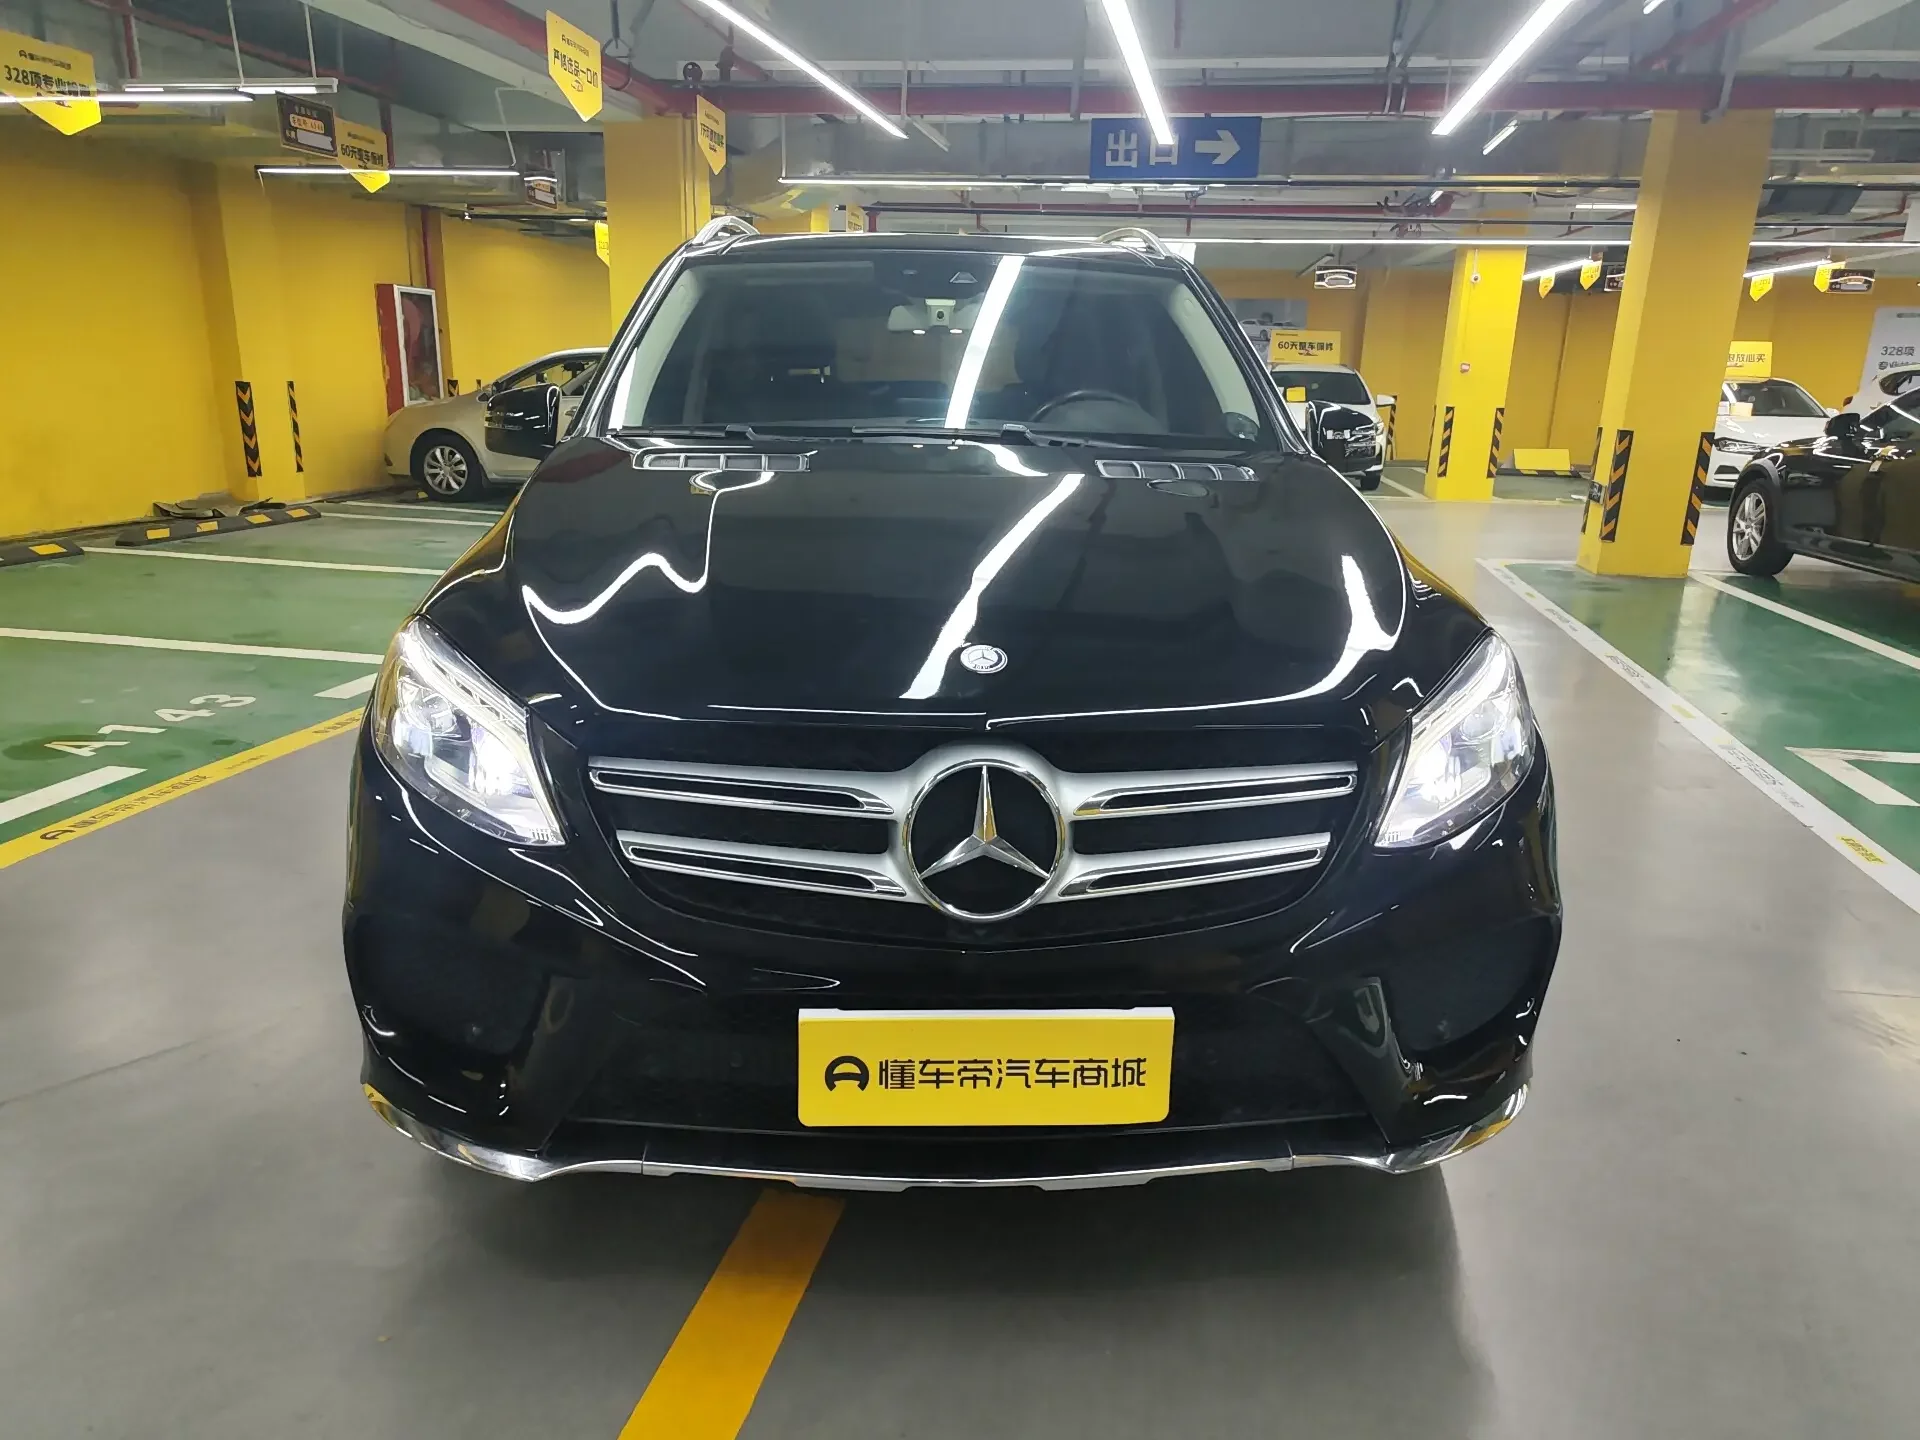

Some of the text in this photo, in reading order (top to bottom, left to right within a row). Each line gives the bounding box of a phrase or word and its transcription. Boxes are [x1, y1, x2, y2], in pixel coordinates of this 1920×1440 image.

[1105, 129, 1179, 168] 出口
[1880, 345, 1915, 357] 328项
[44, 694, 257, 757] A143
[878, 1056, 1147, 1090] 懂车帝汽车商城
